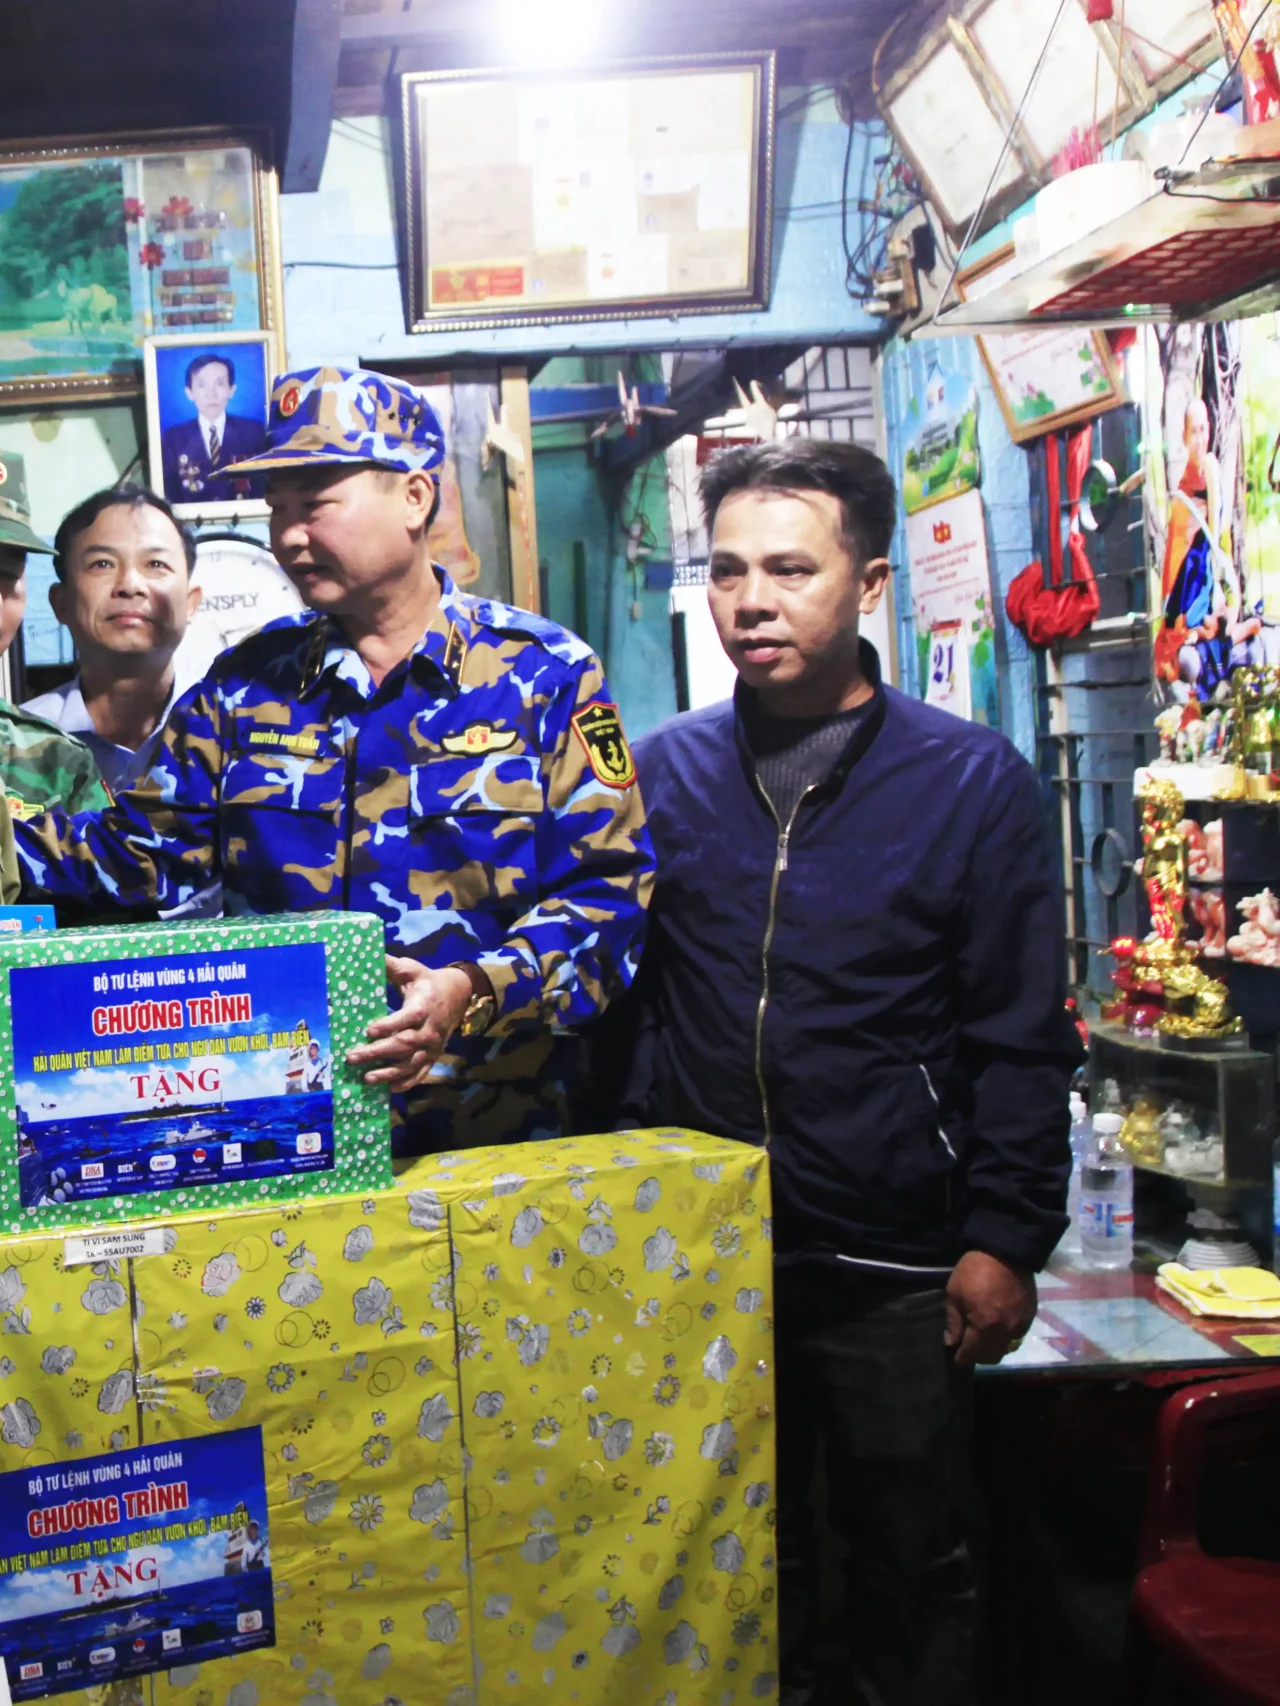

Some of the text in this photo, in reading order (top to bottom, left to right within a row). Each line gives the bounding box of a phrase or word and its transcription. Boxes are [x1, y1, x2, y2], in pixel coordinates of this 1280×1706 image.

[198, 592, 259, 612] ENTSPLY
[933, 643, 954, 684] 21
[93, 961, 247, 994] BỘ TƯ LỆNH VÙNG 4 HẢI QUÂN
[92, 991, 252, 1037] CHƯƠNG TRÌNH
[33, 1050, 48, 1072] HẢI
[50, 1050, 72, 1072] QUÂN
[74, 1048, 91, 1071] VIỆT
[93, 1049, 113, 1066] NAM
[173, 1041, 189, 1058] CHO
[191, 1038, 209, 1057] NGƯ
[210, 1035, 226, 1055] DÂN
[228, 1034, 249, 1053] VƯƠN
[130, 1068, 221, 1103] TẶNG
[85, 1166, 101, 1177] DNA
[102, 1235, 121, 1245] SAM
[123, 1232, 146, 1242] SUNG
[28, 1450, 183, 1497] BỘ TƯ LỆNH VÙNG 4 HẢI QUÂN
[28, 1481, 189, 1538] CHƯƠNG TRÌNH
[10, 1552, 27, 1575] VIỆT
[29, 1550, 48, 1568] NAM
[110, 1535, 126, 1553] CHO
[67, 1557, 158, 1598] TẶNG
